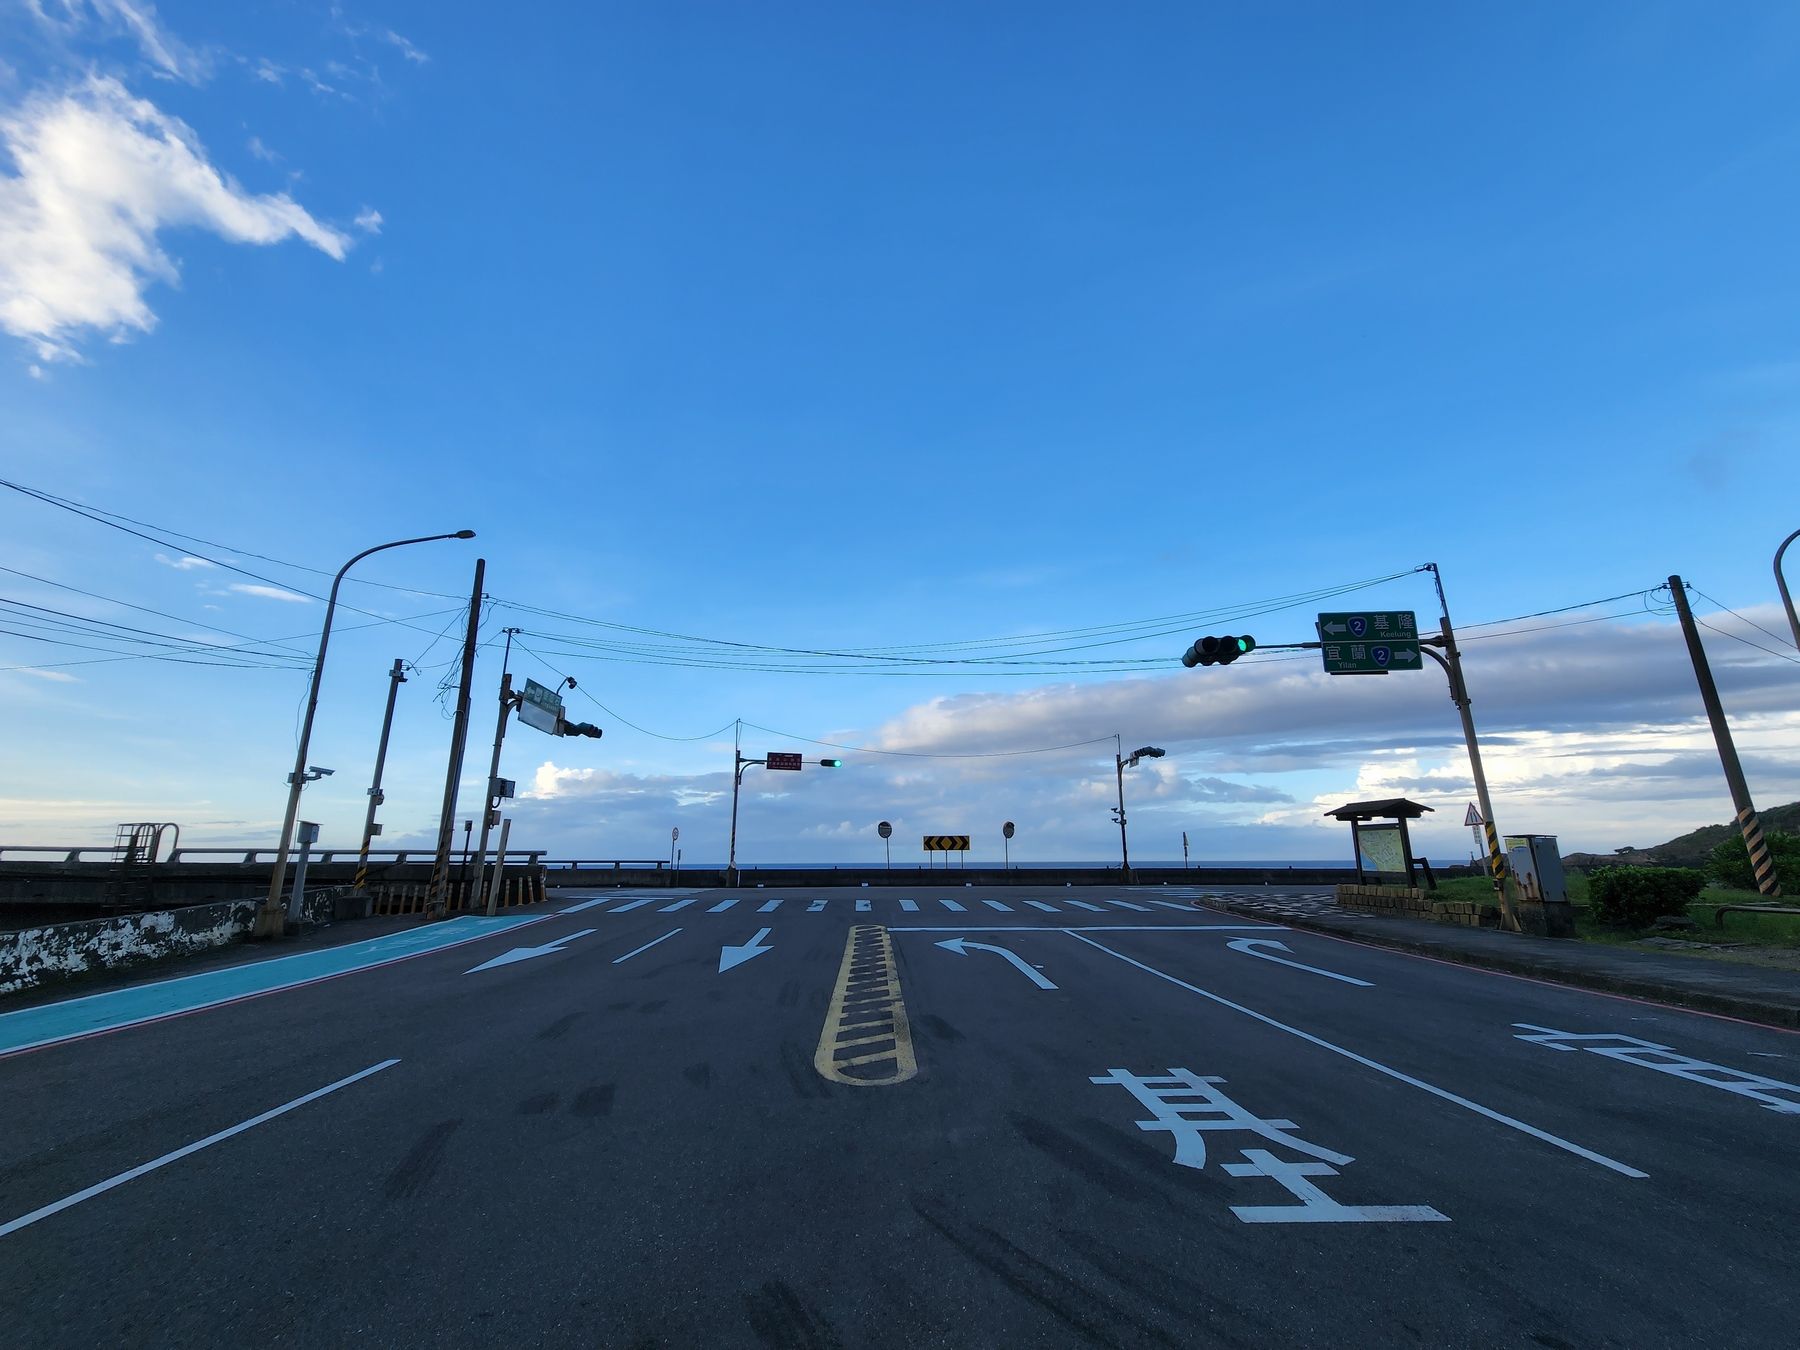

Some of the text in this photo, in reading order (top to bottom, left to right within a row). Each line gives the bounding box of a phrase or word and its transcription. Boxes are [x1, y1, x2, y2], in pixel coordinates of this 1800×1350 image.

[1354, 621, 1362, 631] 2
[1373, 614, 1414, 630] 基隆
[1380, 631, 1411, 639] Keelung
[1326, 644, 1366, 660] 宜蘭
[1377, 650, 1386, 660] 2
[1337, 661, 1357, 669] Yilan
